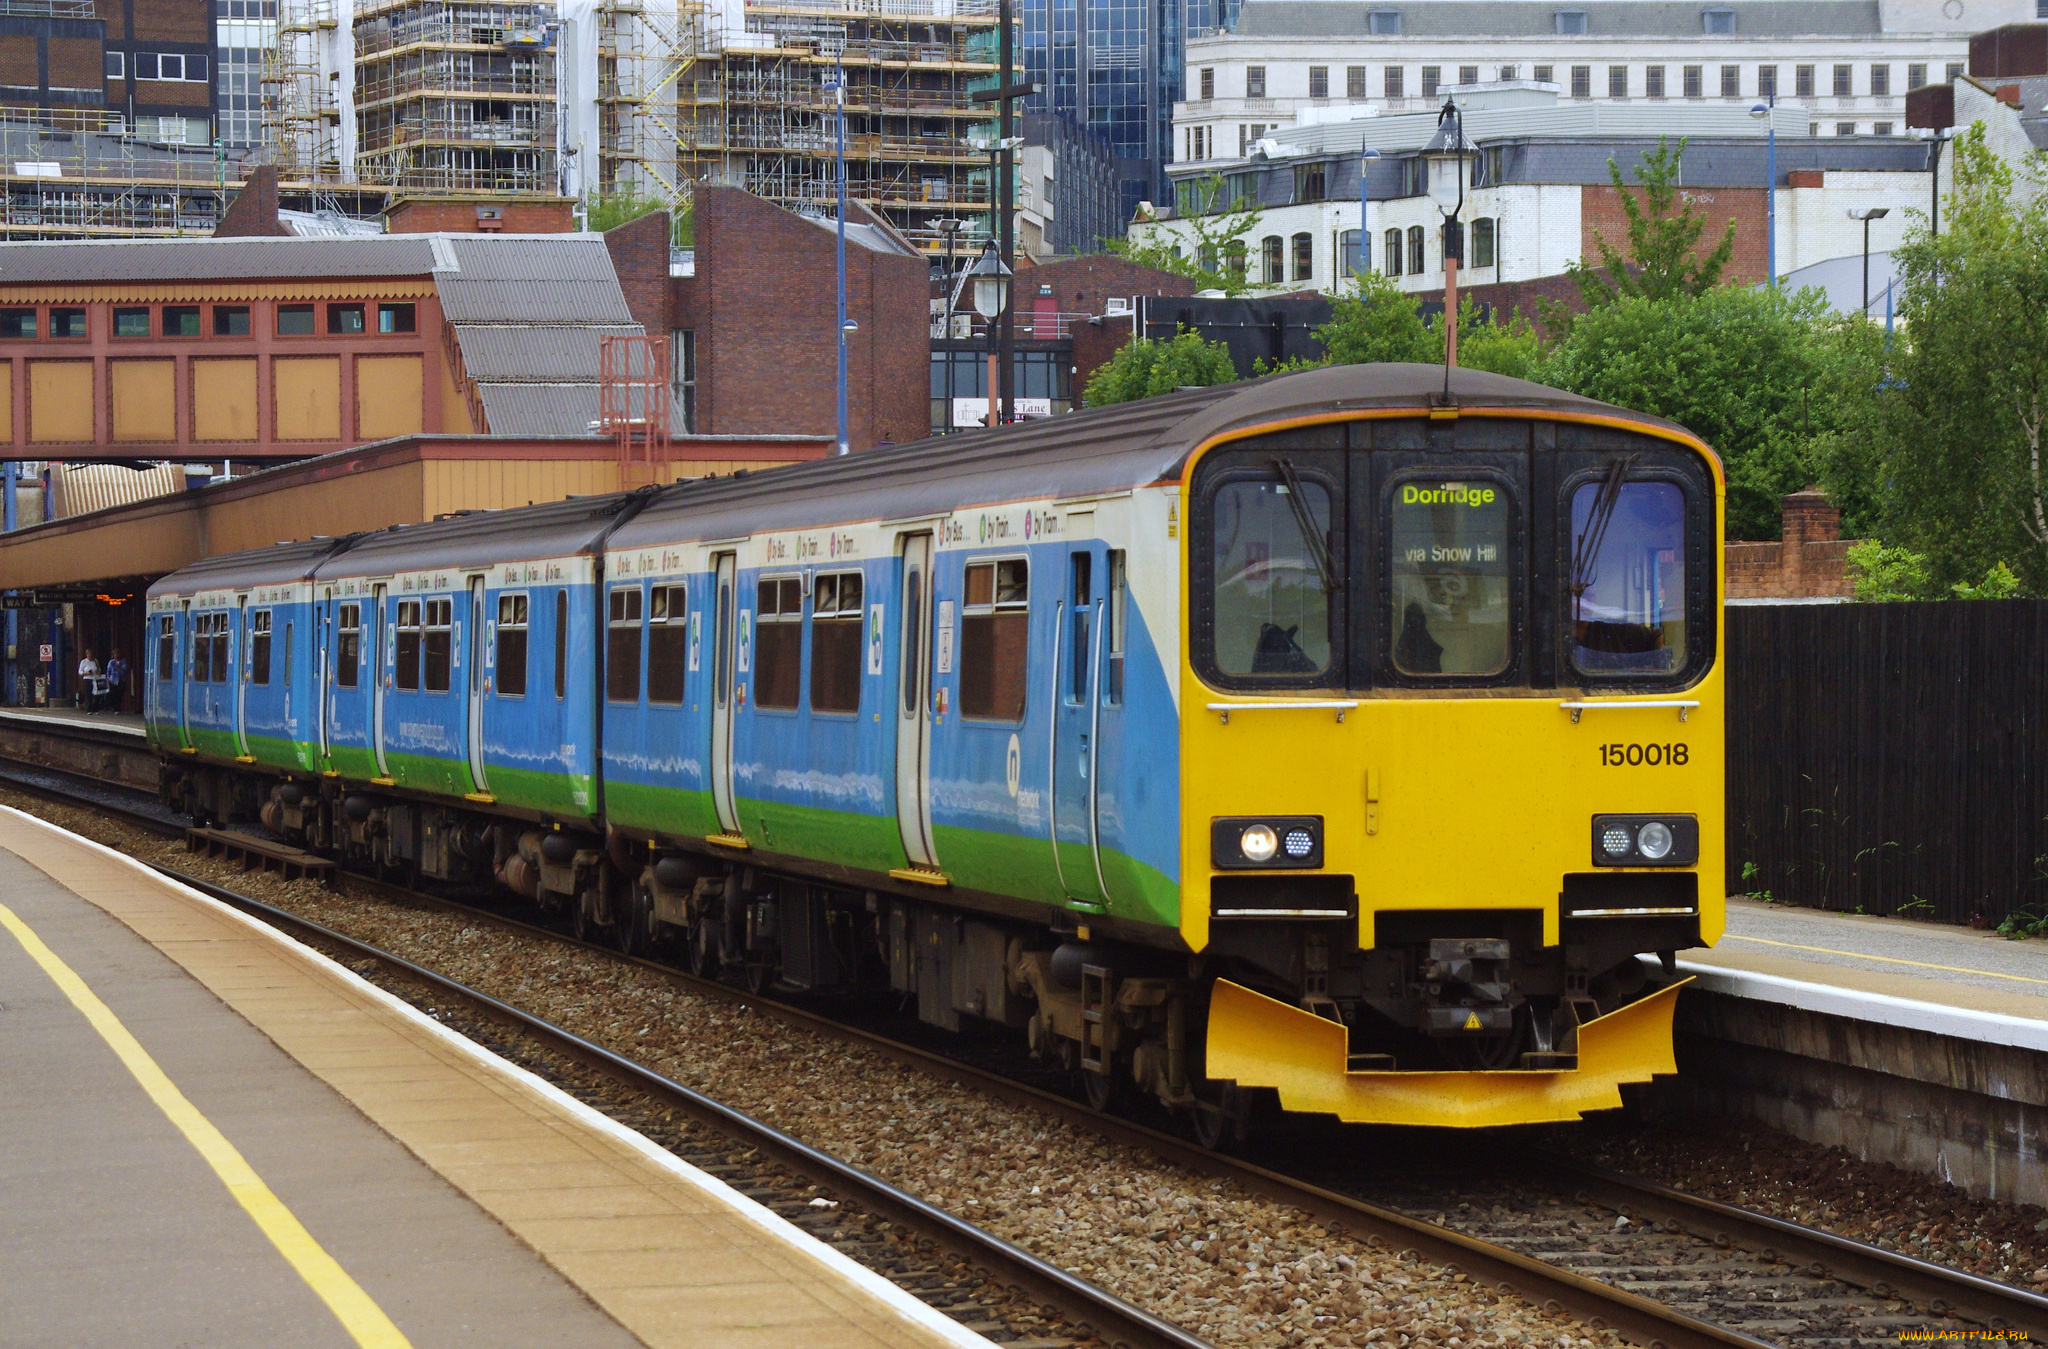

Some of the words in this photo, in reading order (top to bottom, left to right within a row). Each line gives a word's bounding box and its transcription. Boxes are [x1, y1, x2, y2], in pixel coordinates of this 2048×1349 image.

[1022, 404, 1046, 413] Lane
[1403, 485, 1495, 507] Dorridge
[1405, 546, 1426, 562] via
[1431, 544, 1471, 562] Snow
[1477, 544, 1497, 562] Hill
[6, 599, 26, 607] WAY
[1599, 743, 1689, 766] 150018
